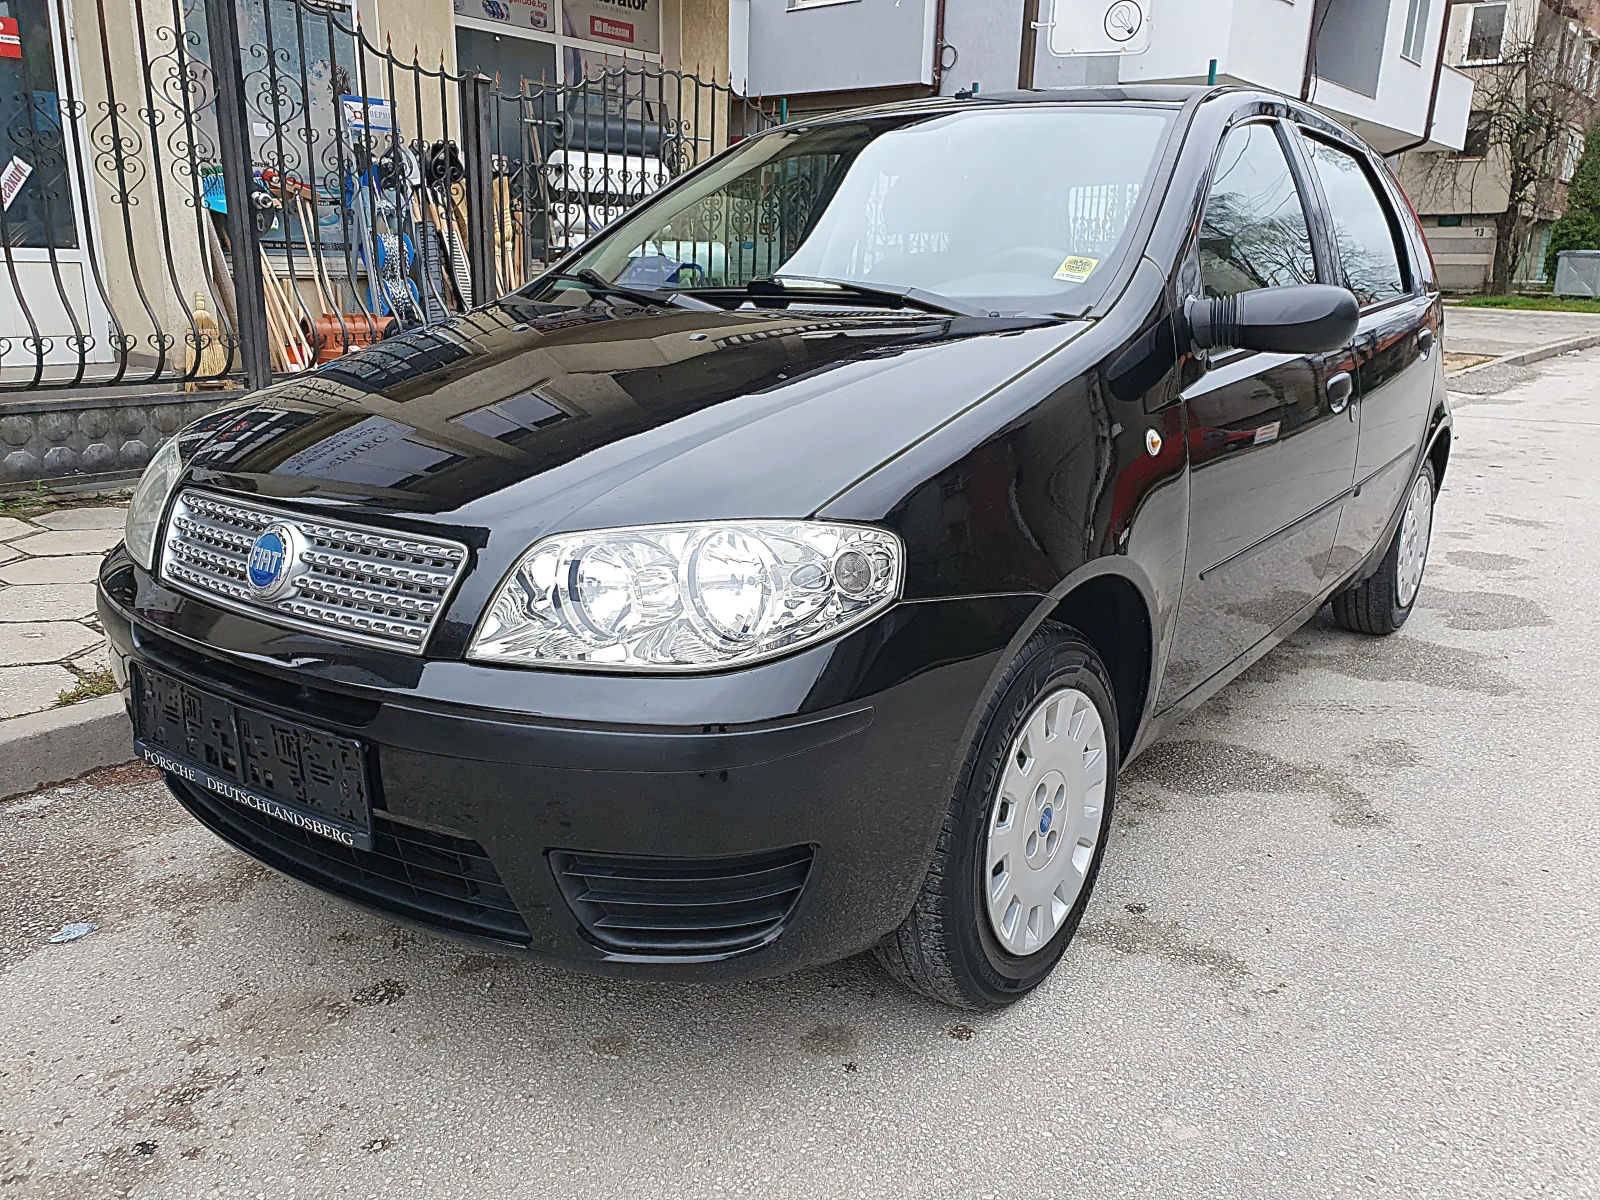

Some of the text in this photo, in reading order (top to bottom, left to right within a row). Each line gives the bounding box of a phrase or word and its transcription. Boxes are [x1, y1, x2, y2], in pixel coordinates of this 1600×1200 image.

[250, 546, 281, 574] FIAT
[144, 750, 355, 846] PORSCHE DEUTSCHLANDSBERG
